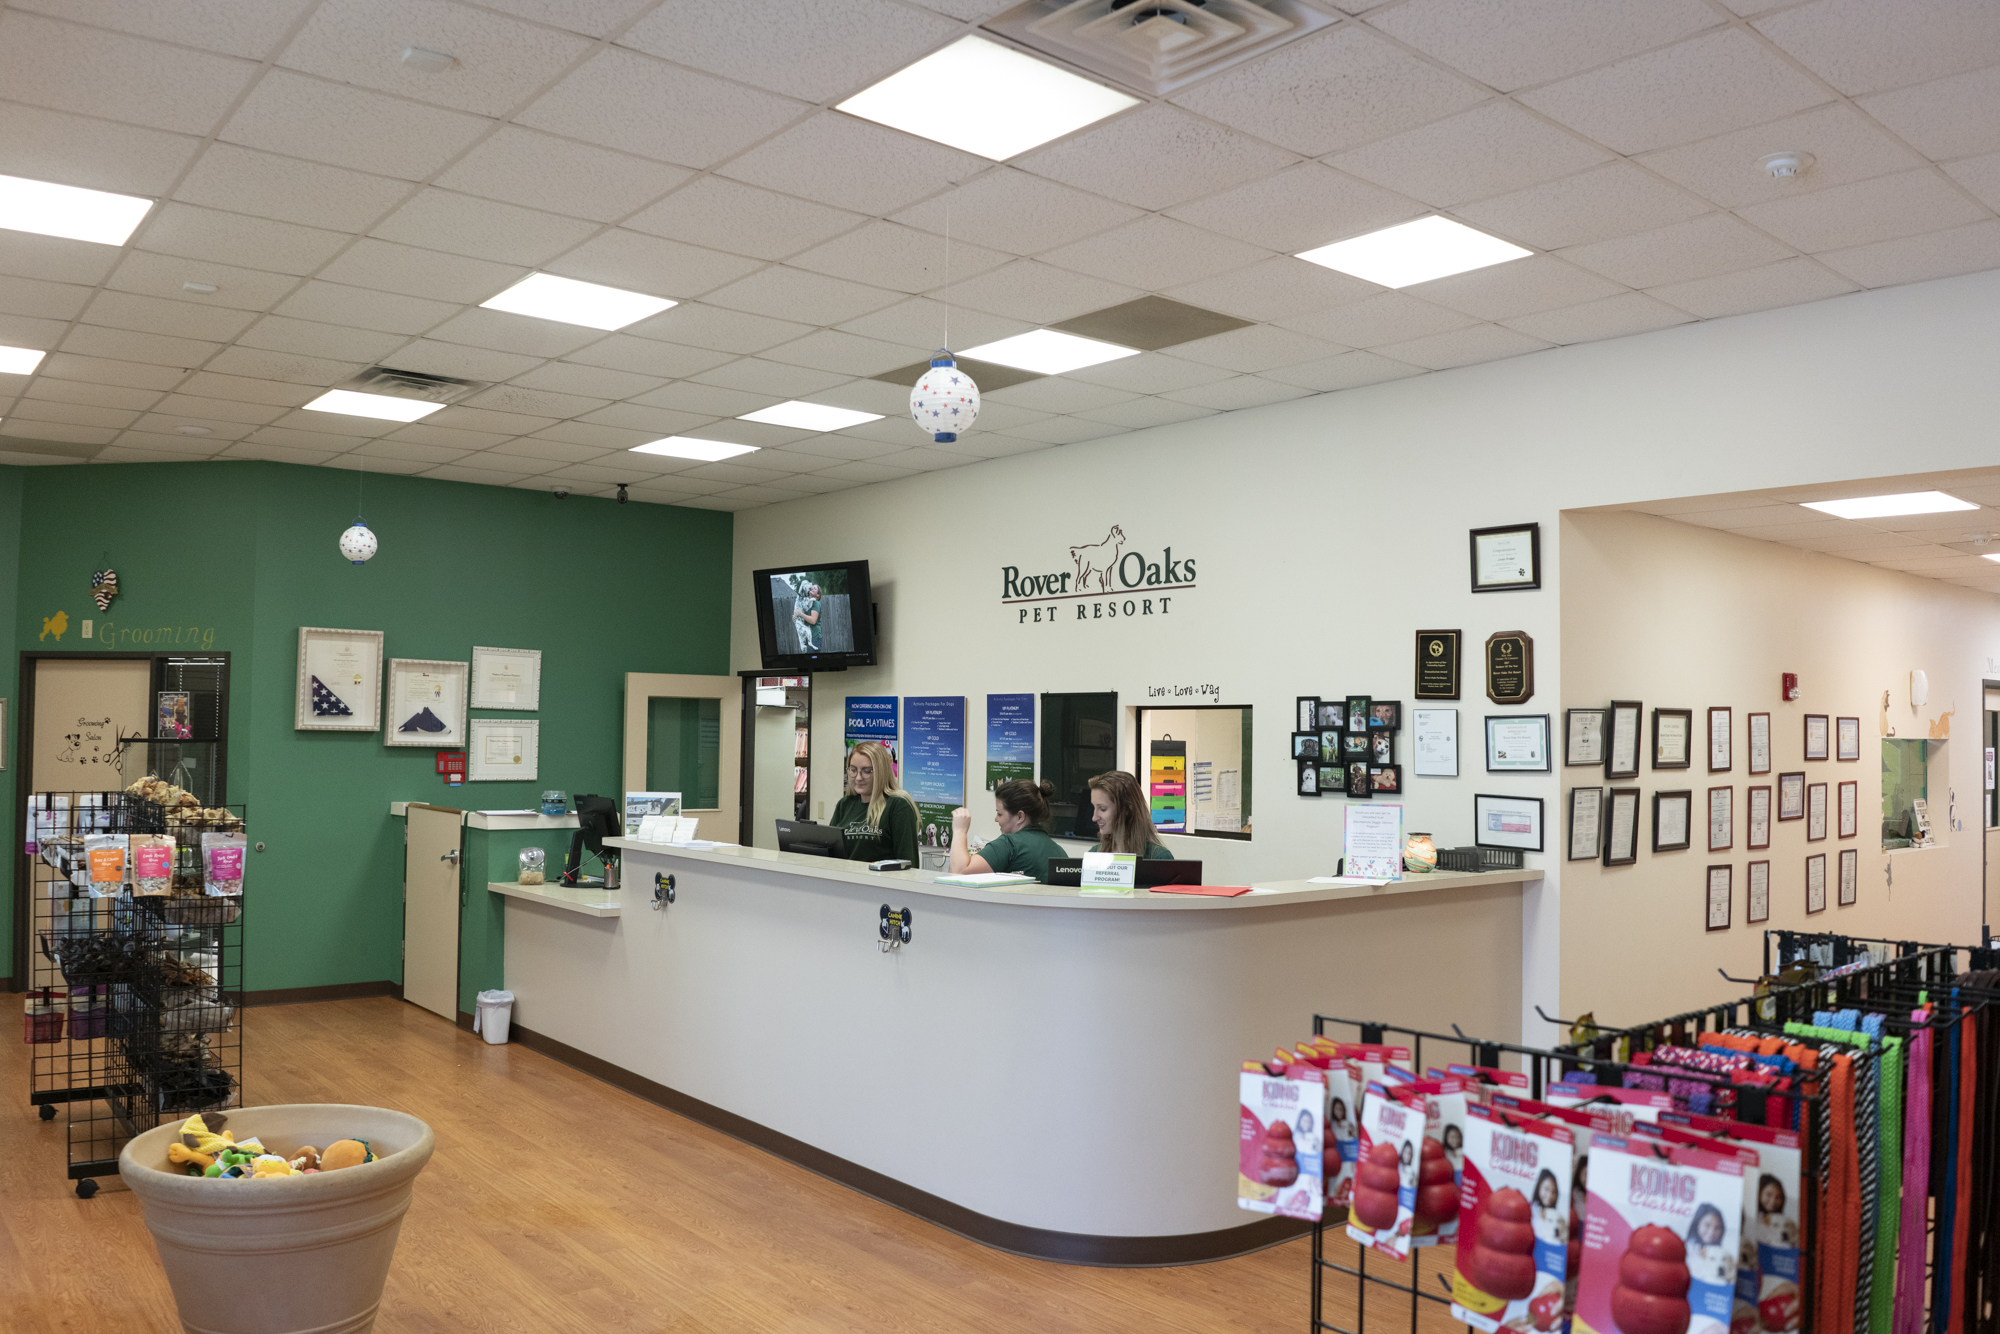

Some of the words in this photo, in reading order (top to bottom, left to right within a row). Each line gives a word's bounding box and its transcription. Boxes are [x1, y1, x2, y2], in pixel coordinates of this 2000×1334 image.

[1002, 565, 1071, 598] Rover
[1119, 546, 1196, 588] Oaks
[1019, 606, 1057, 623] PET
[1077, 597, 1171, 619] RESORT
[100, 622, 216, 650] Grooming
[1148, 686, 1165, 697] Live
[1174, 685, 1193, 697] Love
[1200, 684, 1220, 703] Wag
[77, 717, 105, 728] Grooming
[849, 718, 865, 727] POOL
[865, 718, 895, 728] PLAYTIMES
[85, 732, 102, 741] Salon
[1262, 1081, 1299, 1102] KONG
[1491, 1130, 1538, 1168] KONG
[1630, 1163, 1696, 1204] KONG
